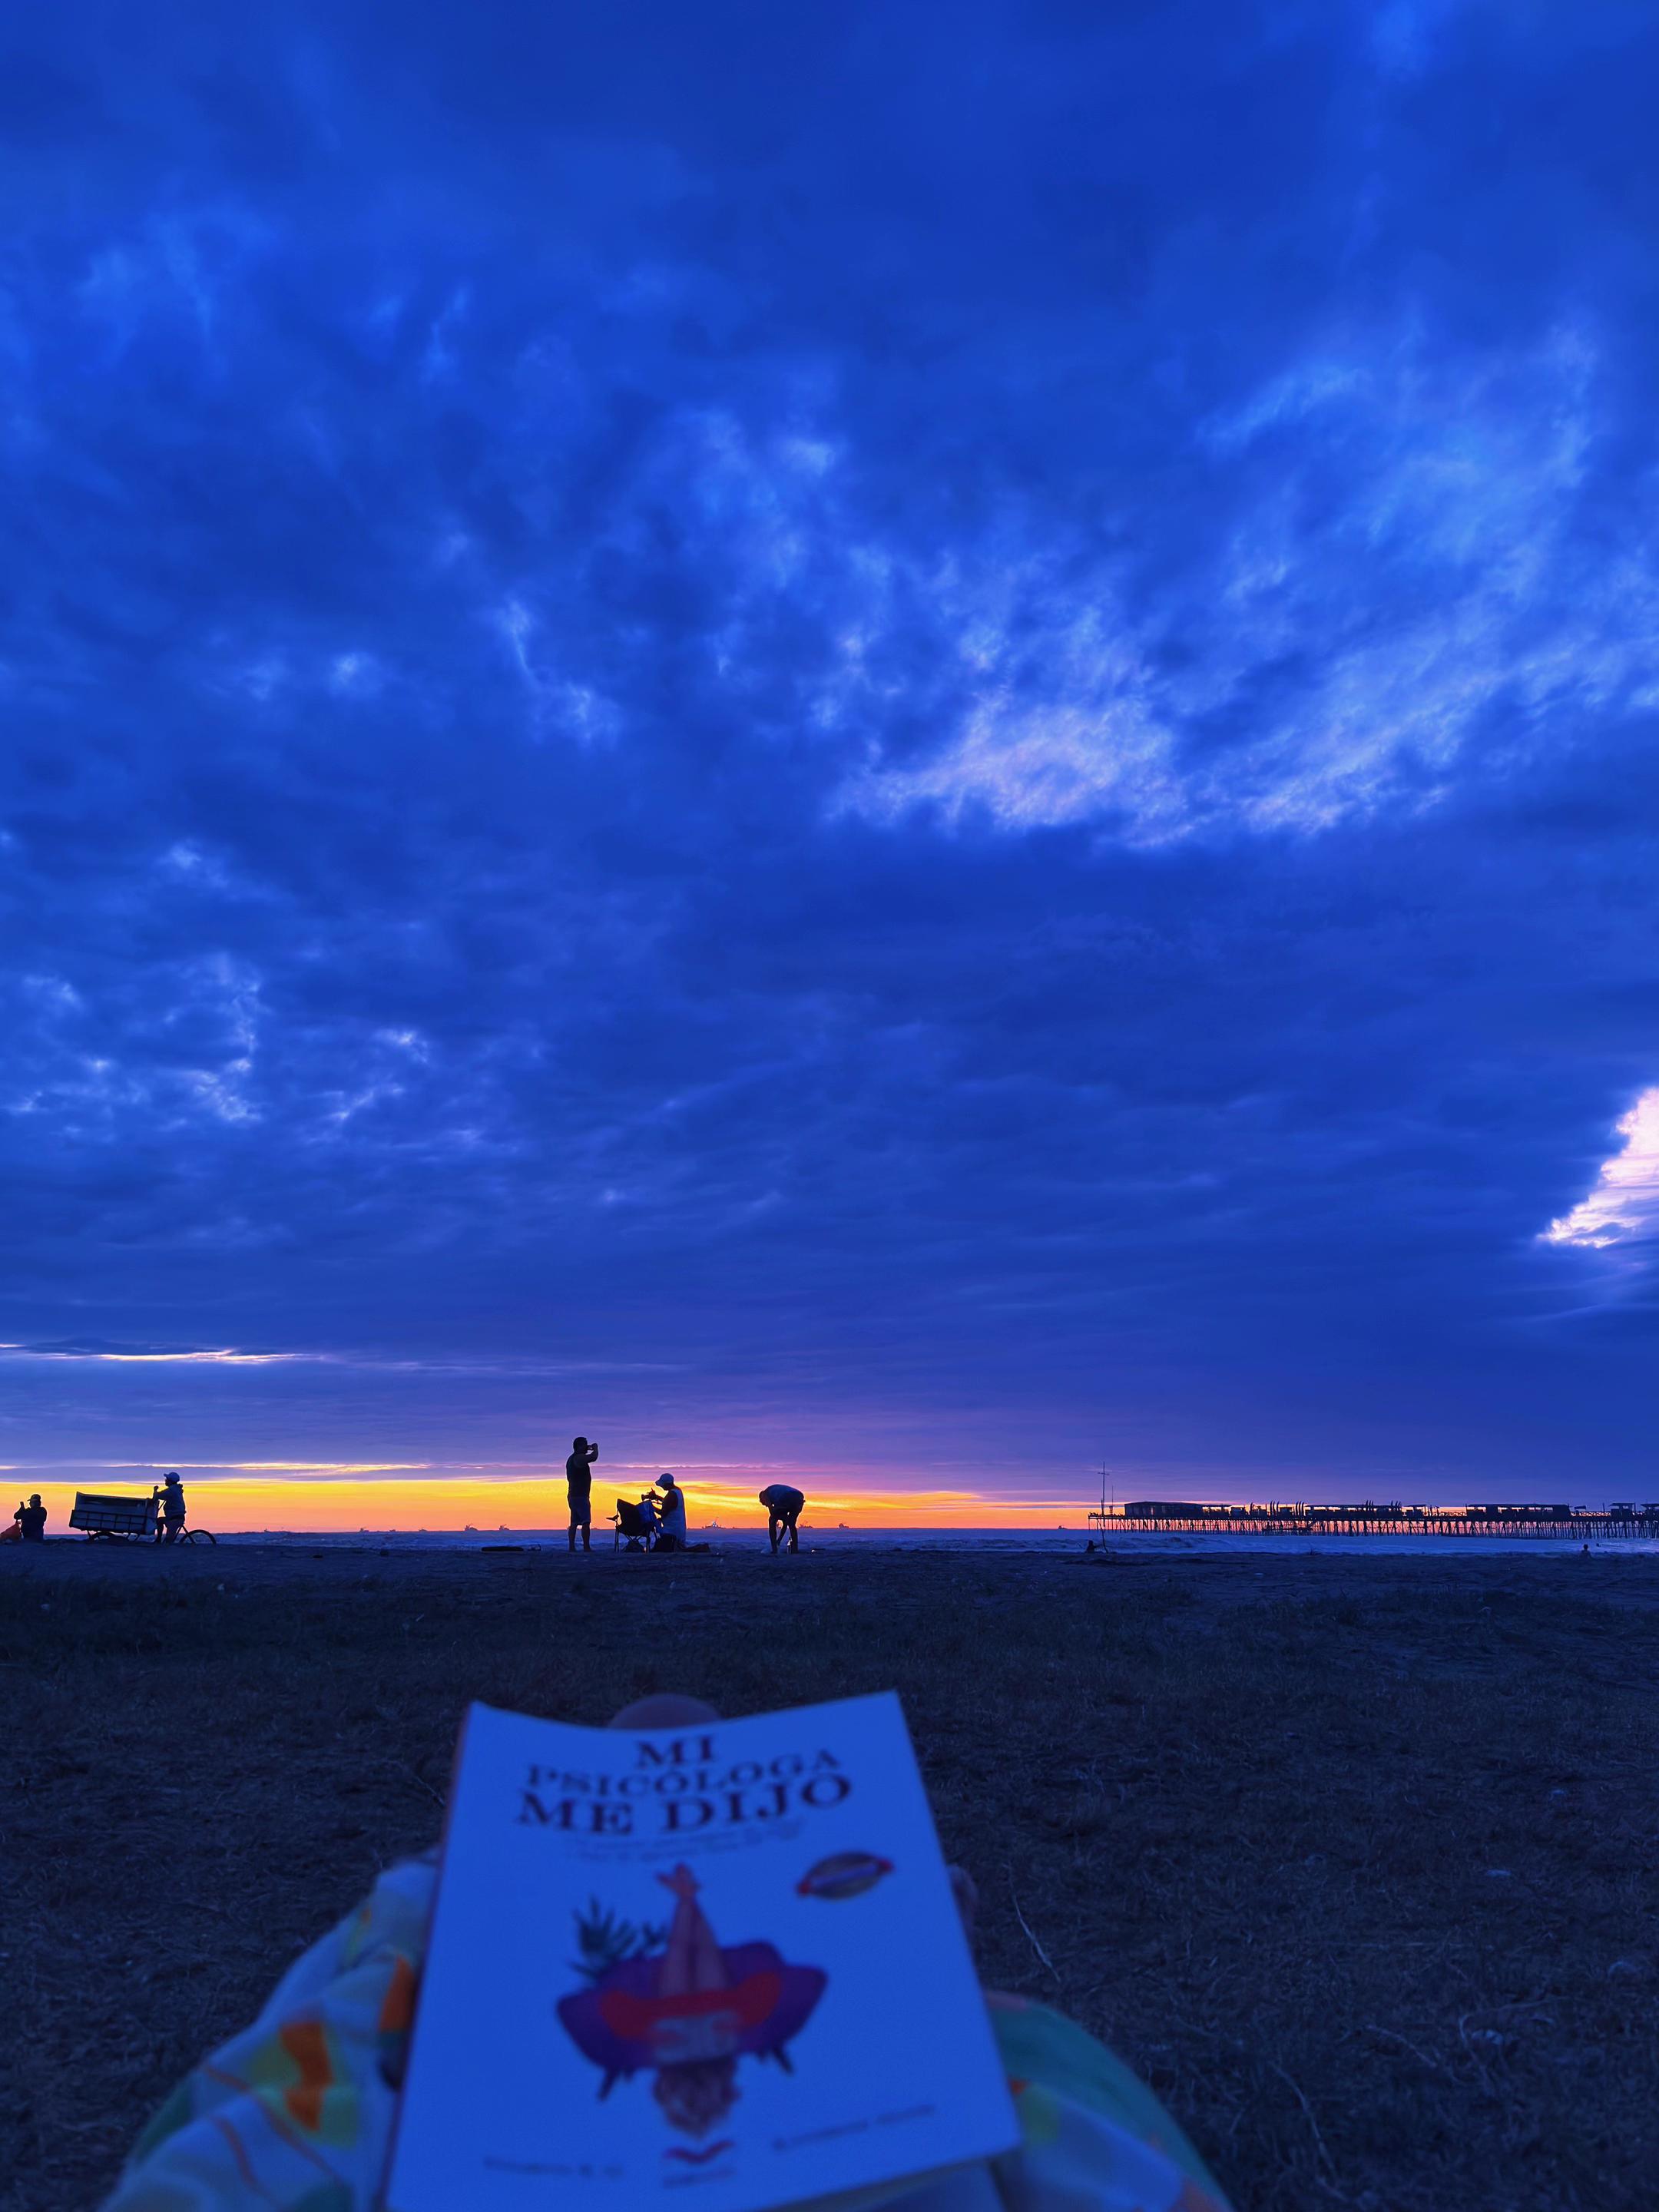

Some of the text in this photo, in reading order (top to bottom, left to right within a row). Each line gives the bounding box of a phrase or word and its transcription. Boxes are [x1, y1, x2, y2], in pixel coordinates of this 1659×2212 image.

[636, 1734, 717, 1768] MI
[515, 1791, 634, 1836] ME
[660, 1773, 852, 1832] DIJO
